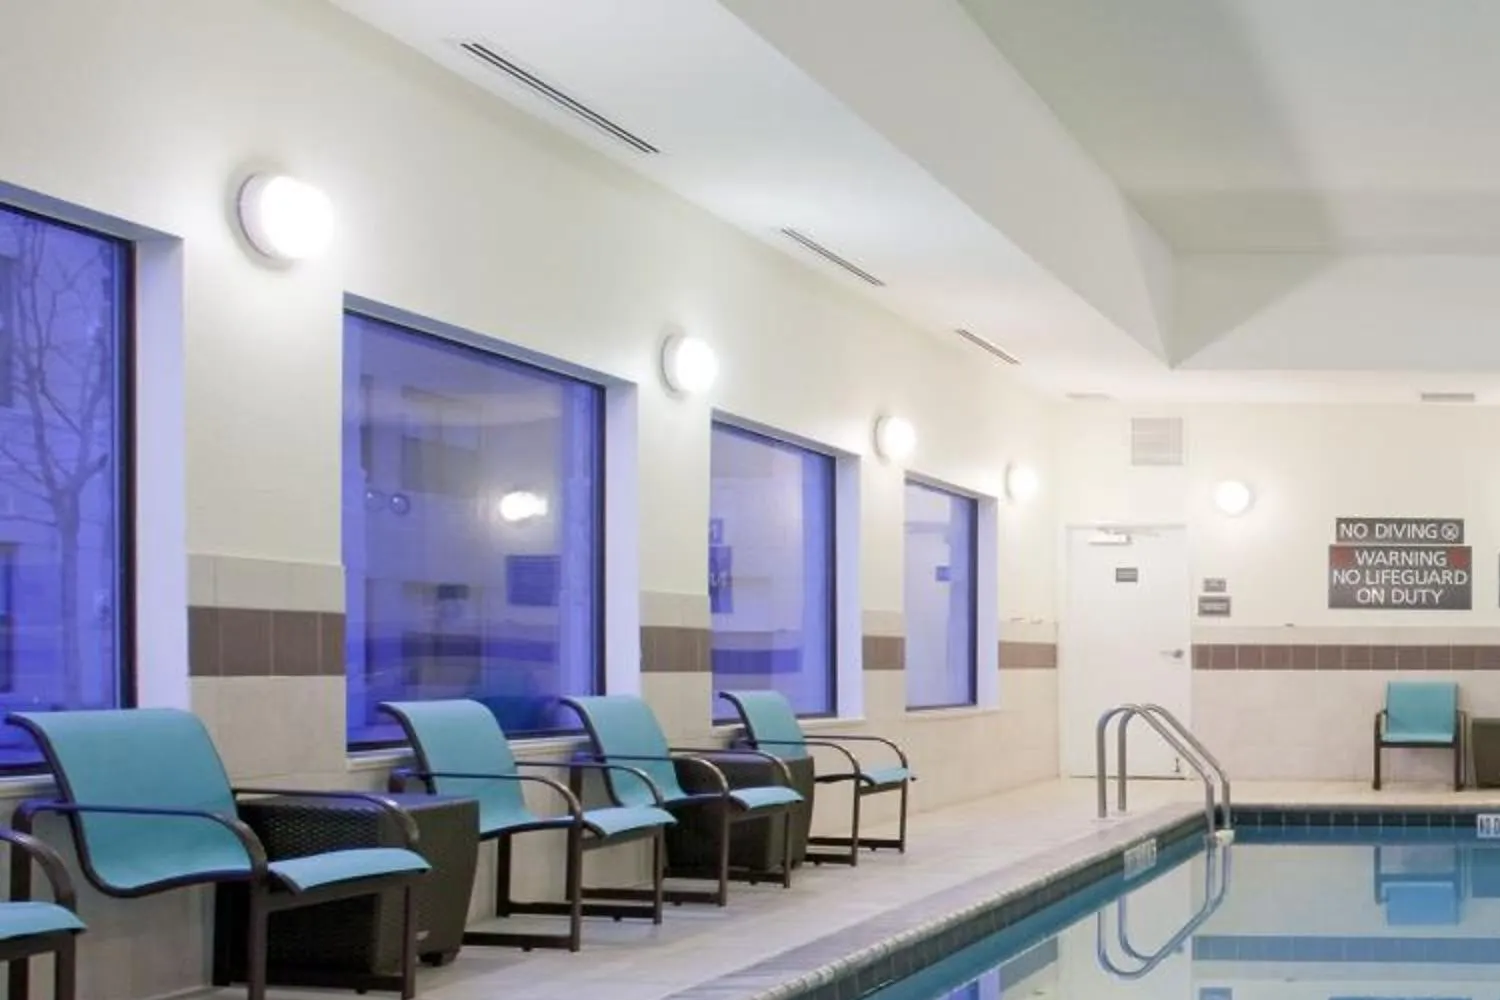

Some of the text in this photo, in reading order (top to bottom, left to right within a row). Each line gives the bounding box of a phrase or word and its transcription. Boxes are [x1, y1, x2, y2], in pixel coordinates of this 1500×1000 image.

[1340, 523, 1438, 539] NO DIVING
[1355, 551, 1447, 567] WARNING
[1333, 569, 1468, 585] NO LIFEGUARD
[1356, 588, 1444, 605] ON DUTY
